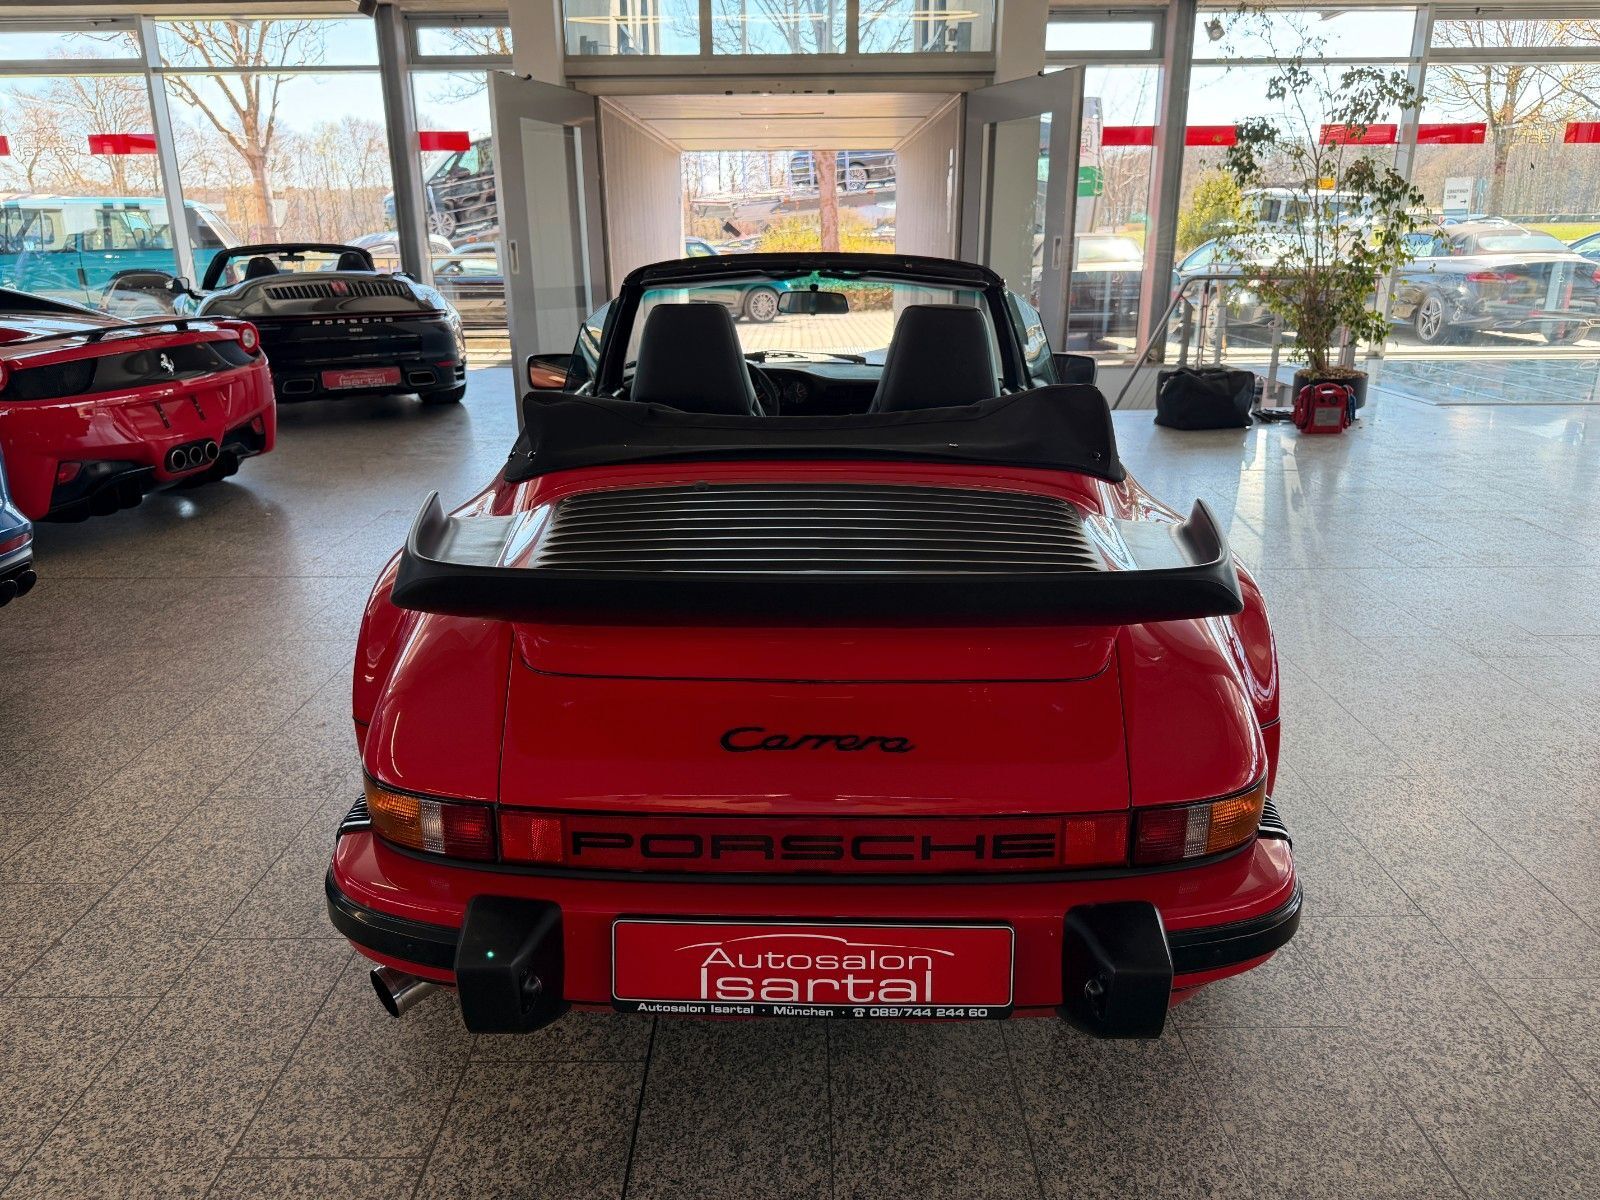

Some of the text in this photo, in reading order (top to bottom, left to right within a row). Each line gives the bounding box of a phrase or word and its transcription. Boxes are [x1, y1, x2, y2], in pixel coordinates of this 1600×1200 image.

[719, 726, 916, 753] Carrera
[572, 831, 1056, 860] PORSCHE
[701, 947, 932, 970] Autosalon
[700, 967, 932, 1003] Isartal
[637, 1002, 988, 1017] Autosalon Isartal München 089/744 244 60
